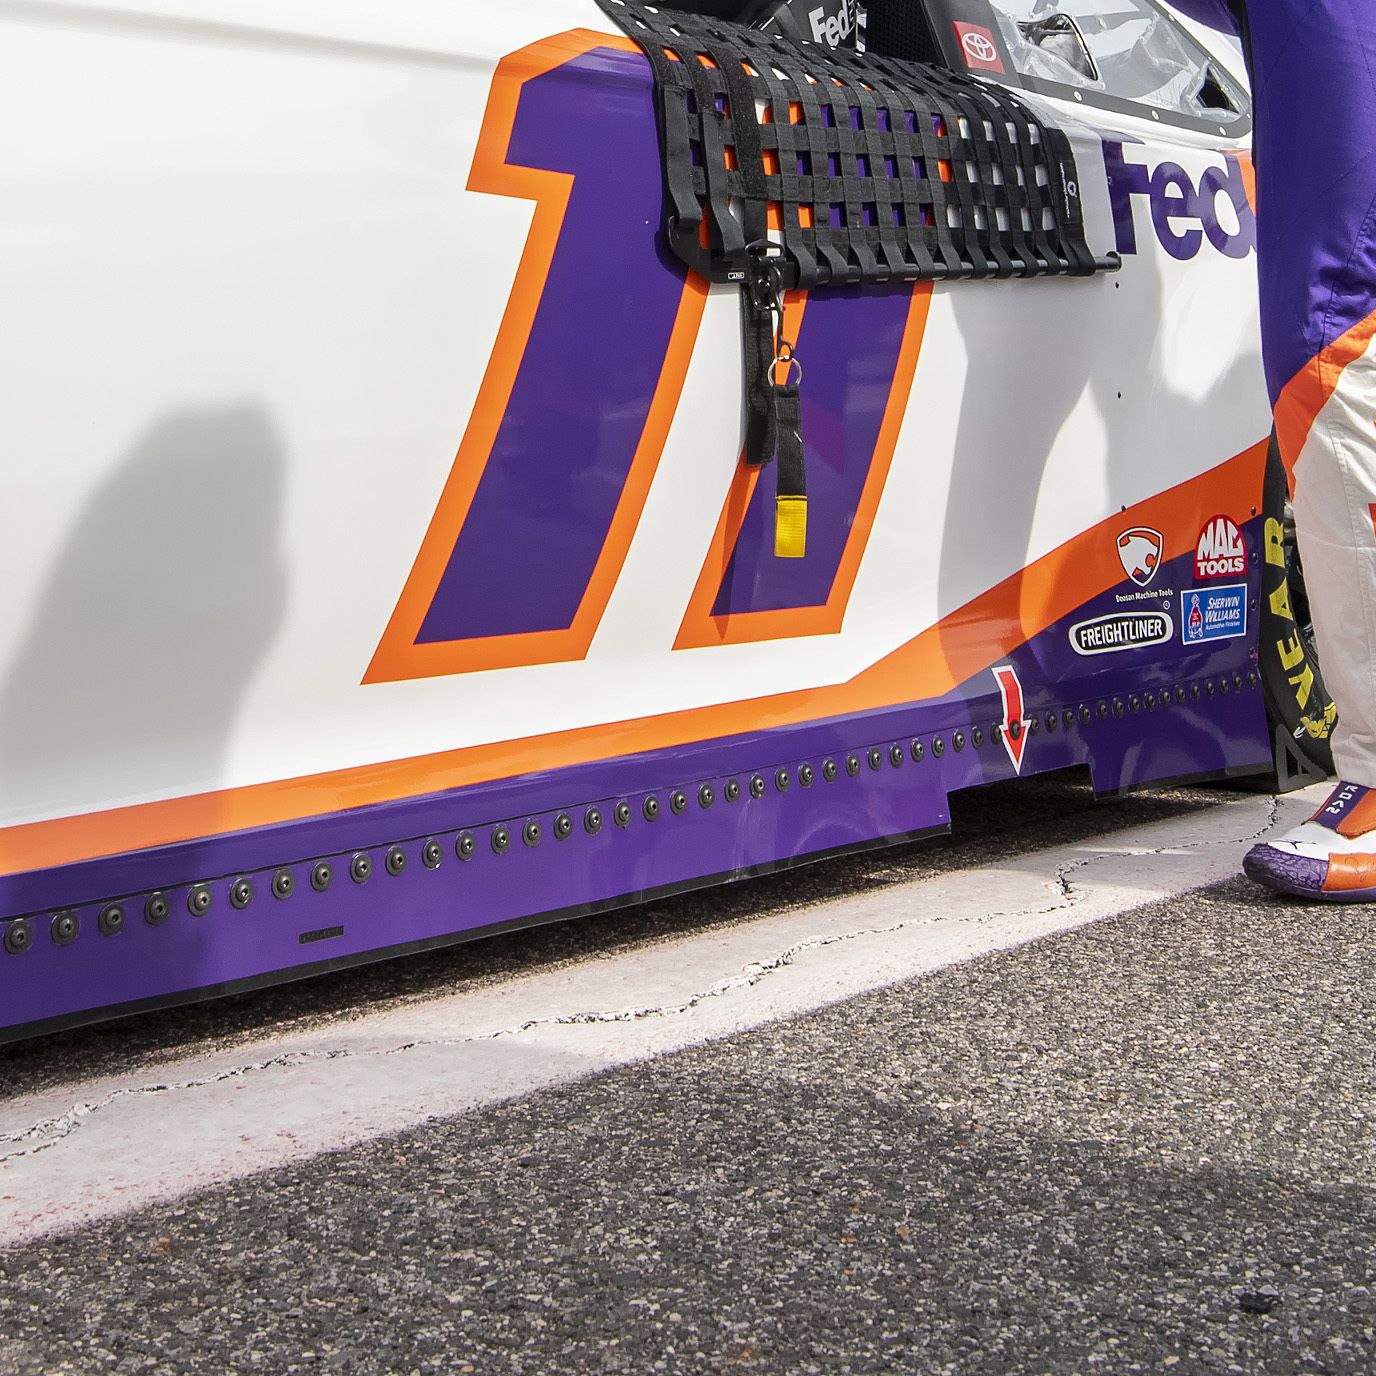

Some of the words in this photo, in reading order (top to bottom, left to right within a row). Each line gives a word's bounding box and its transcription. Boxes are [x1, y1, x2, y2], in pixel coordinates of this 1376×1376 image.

[1197, 518, 1244, 560] MAC
[1197, 558, 1245, 576] TOOLS
[1135, 590, 1159, 602] Machine
[1159, 587, 1174, 598] Tools
[1207, 595, 1240, 611] SHERWIN
[1204, 608, 1241, 624] WILLIAMS
[1080, 618, 1164, 649] FREIGHTLINER
